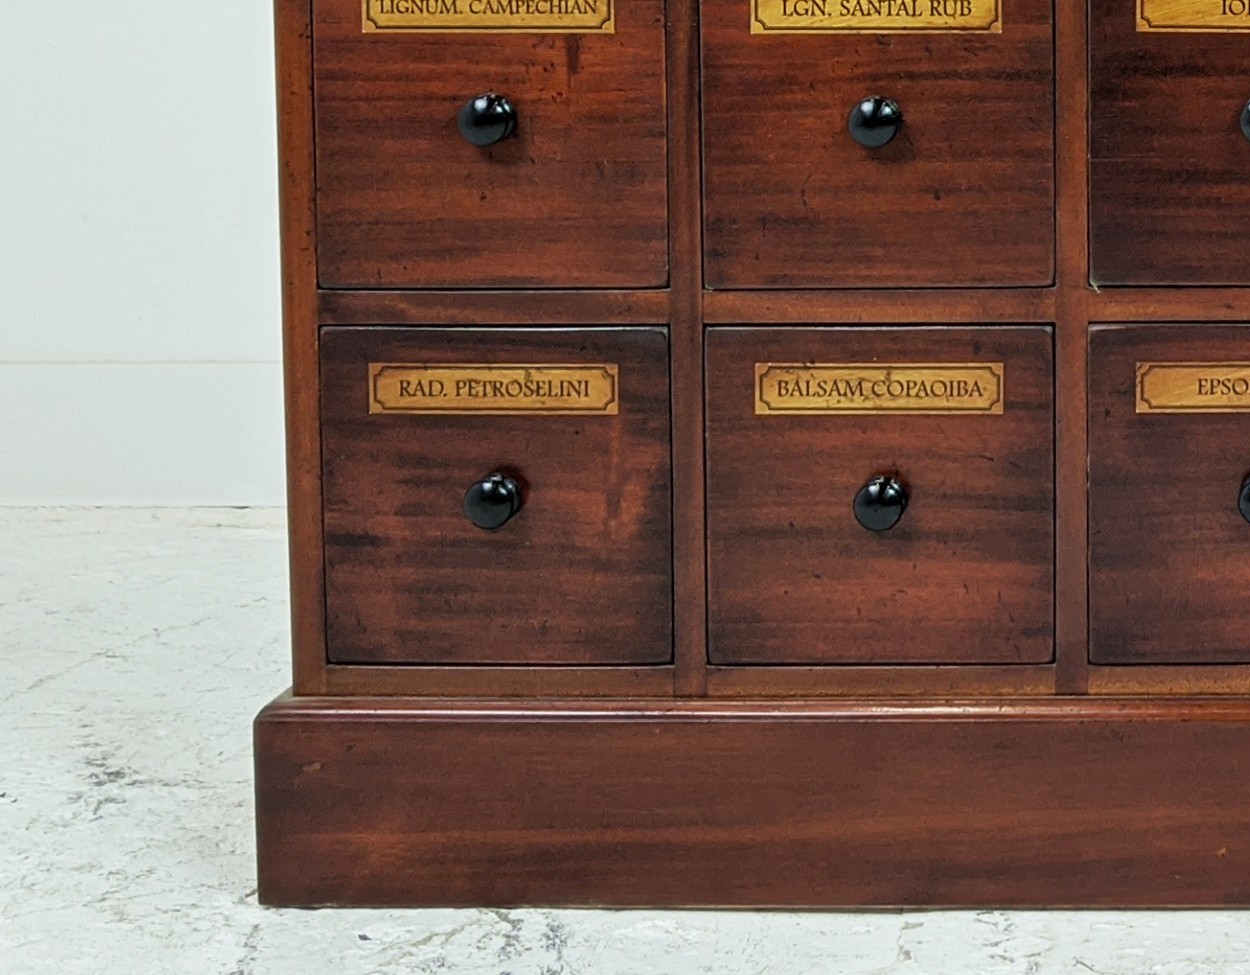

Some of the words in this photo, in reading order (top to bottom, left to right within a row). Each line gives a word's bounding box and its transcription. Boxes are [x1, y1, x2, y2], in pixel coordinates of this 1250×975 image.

[782, 0, 831, 17] LGN.
[839, 0, 922, 17] SANTAL
[929, 0, 972, 17] RUB
[399, 379, 447, 397] RAD.
[455, 379, 590, 398] PETROSELINI
[777, 380, 864, 397] BALSAM
[870, 380, 983, 398] COPAOIBA
